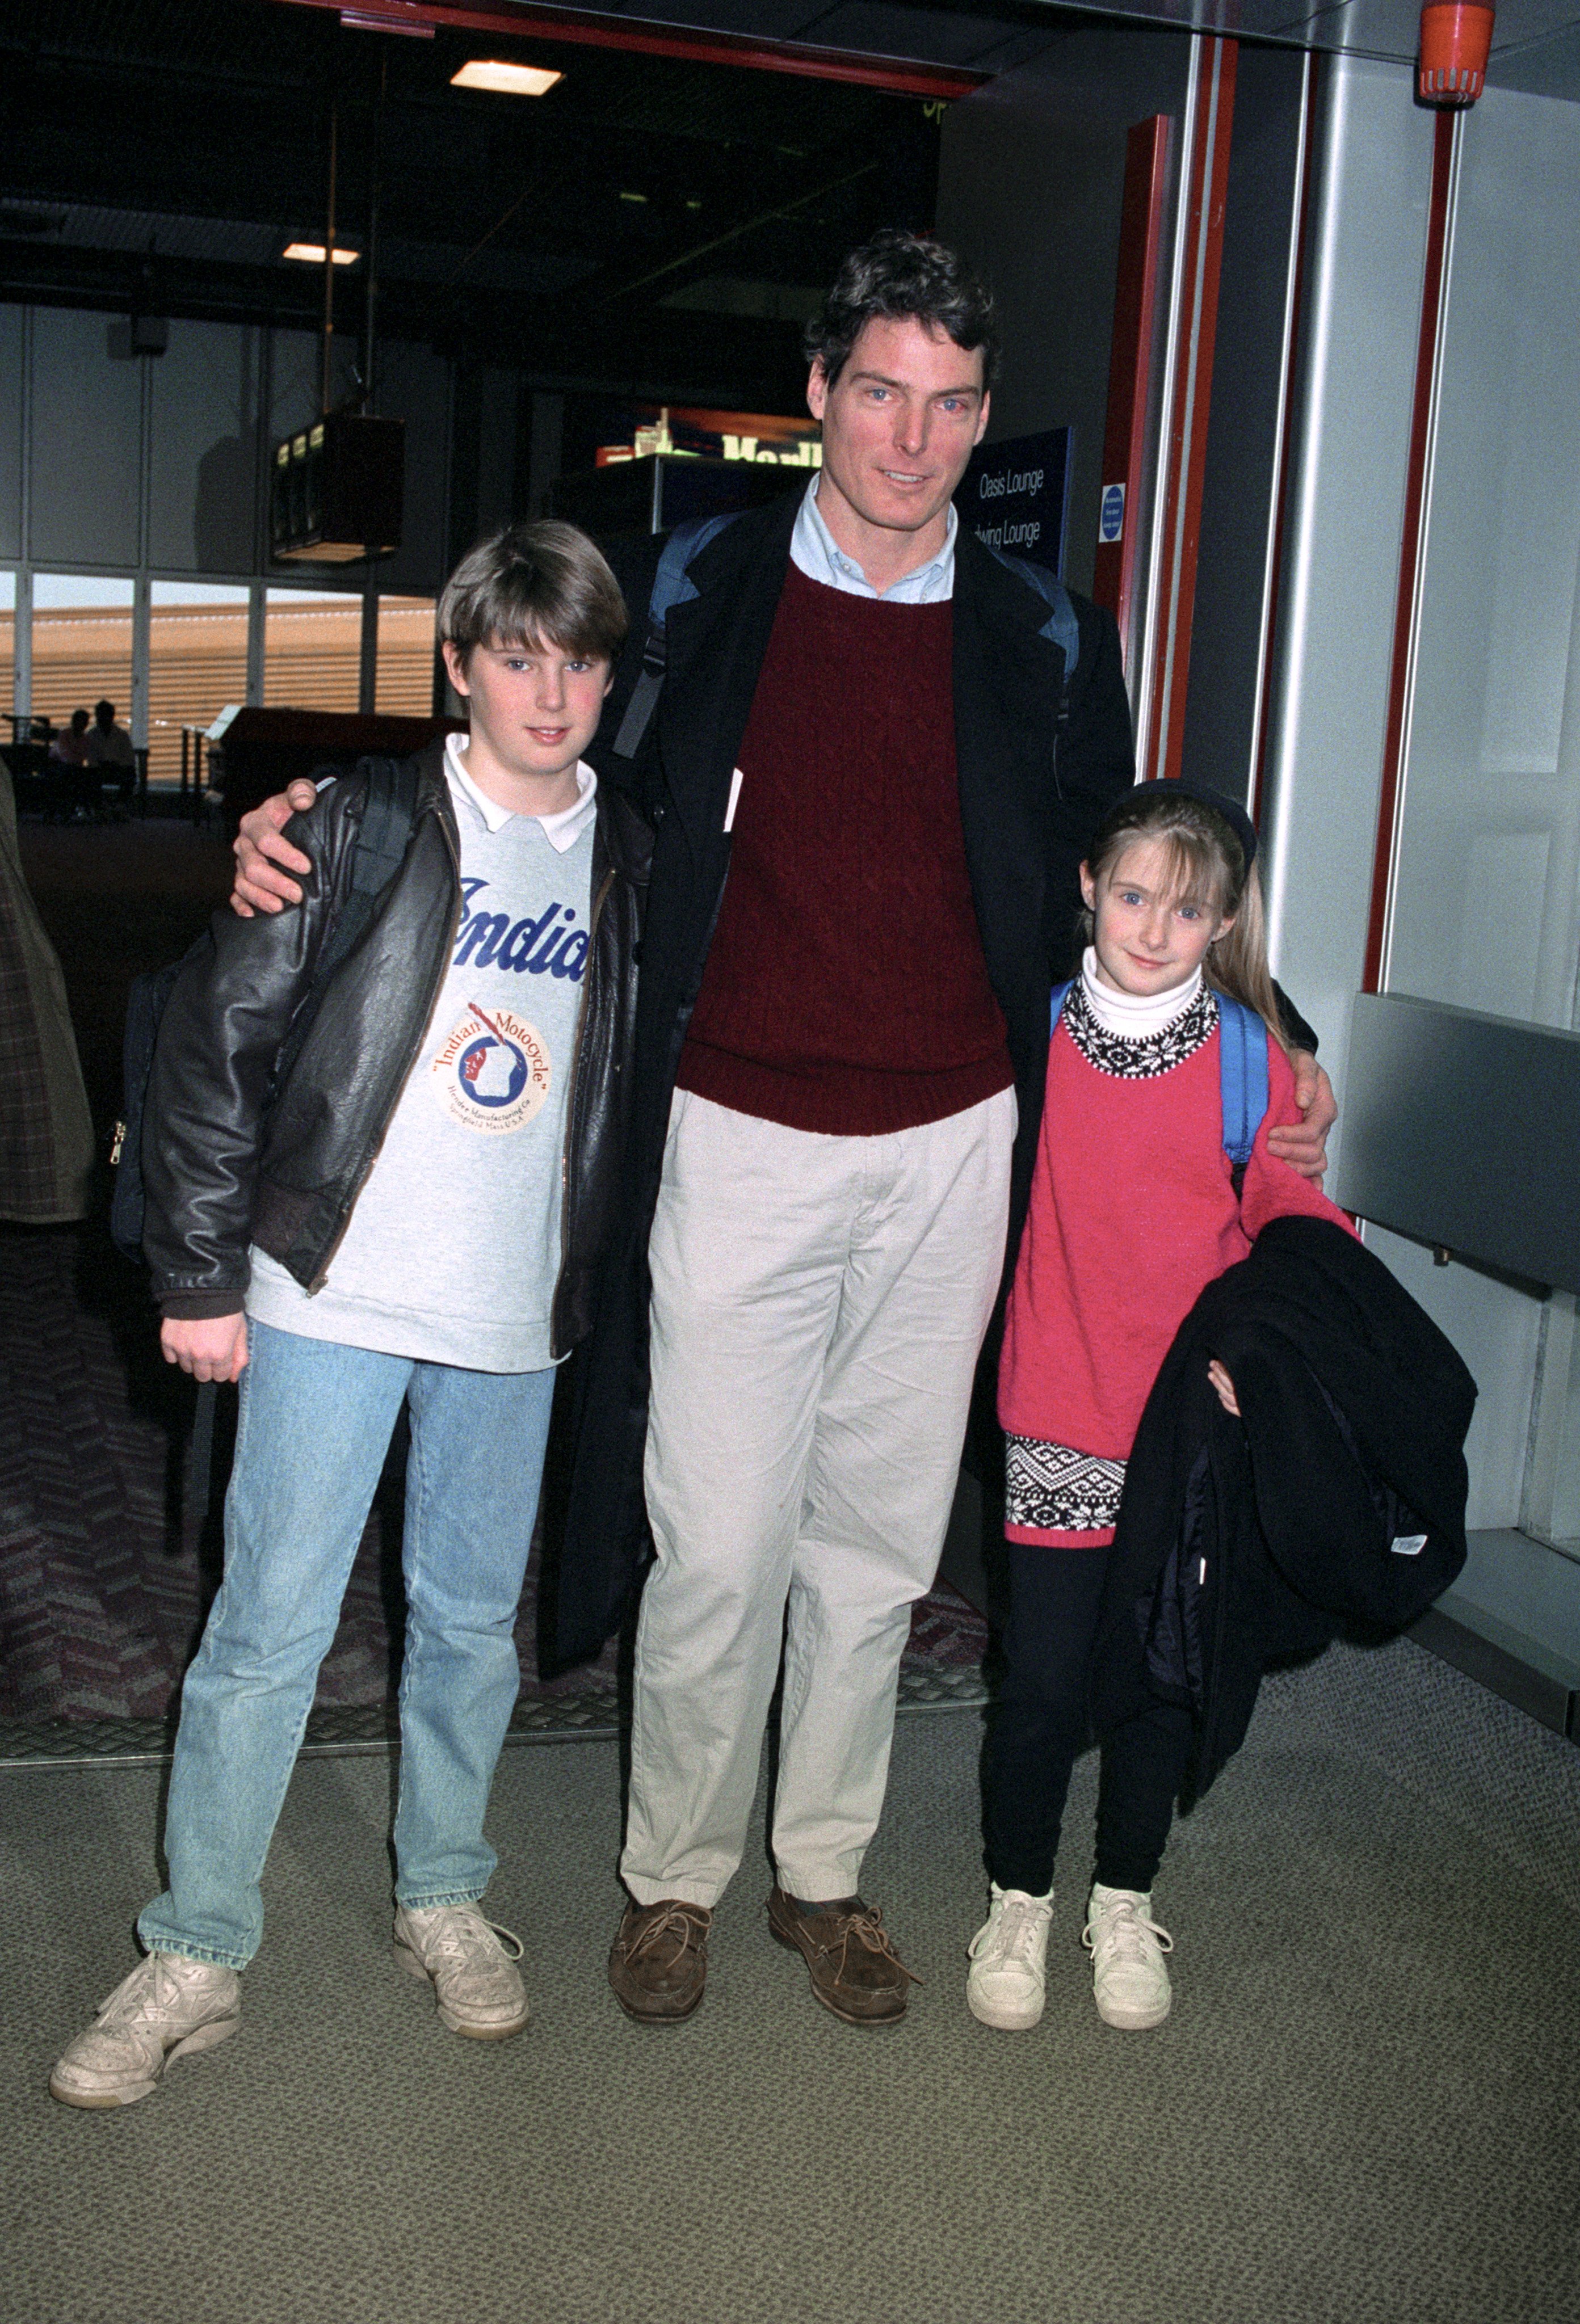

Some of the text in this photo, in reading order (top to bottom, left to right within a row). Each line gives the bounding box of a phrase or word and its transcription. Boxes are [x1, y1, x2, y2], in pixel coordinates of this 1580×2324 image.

[980, 469, 1044, 499] Oasis Lounge
[1003, 520, 1040, 548] Lounge
[472, 1107, 523, 1121] Manufacturing
